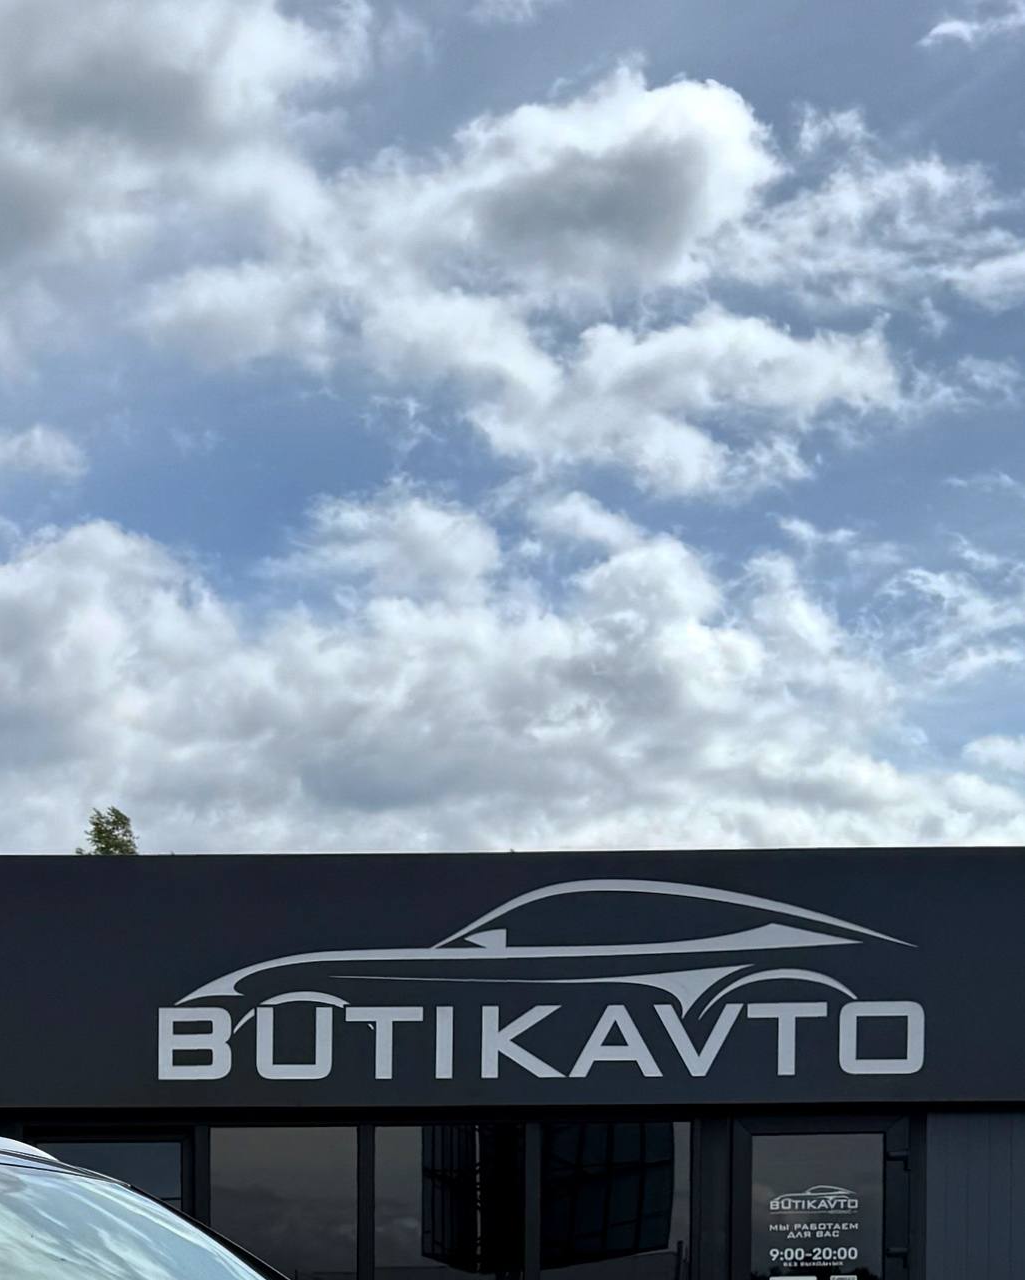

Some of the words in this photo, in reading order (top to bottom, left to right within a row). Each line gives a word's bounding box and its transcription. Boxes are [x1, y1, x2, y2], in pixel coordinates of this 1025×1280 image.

[157, 1000, 926, 1081] BUTIKAVTO
[769, 1199, 859, 1211] BUTIKAVTO
[769, 1224, 790, 1232] МЫ
[793, 1222, 859, 1231] РАБОТАЕМ
[786, 1231, 812, 1239] ДЛЯ
[815, 1230, 840, 1238] ВАС
[769, 1247, 858, 1261] 9:00-20:00
